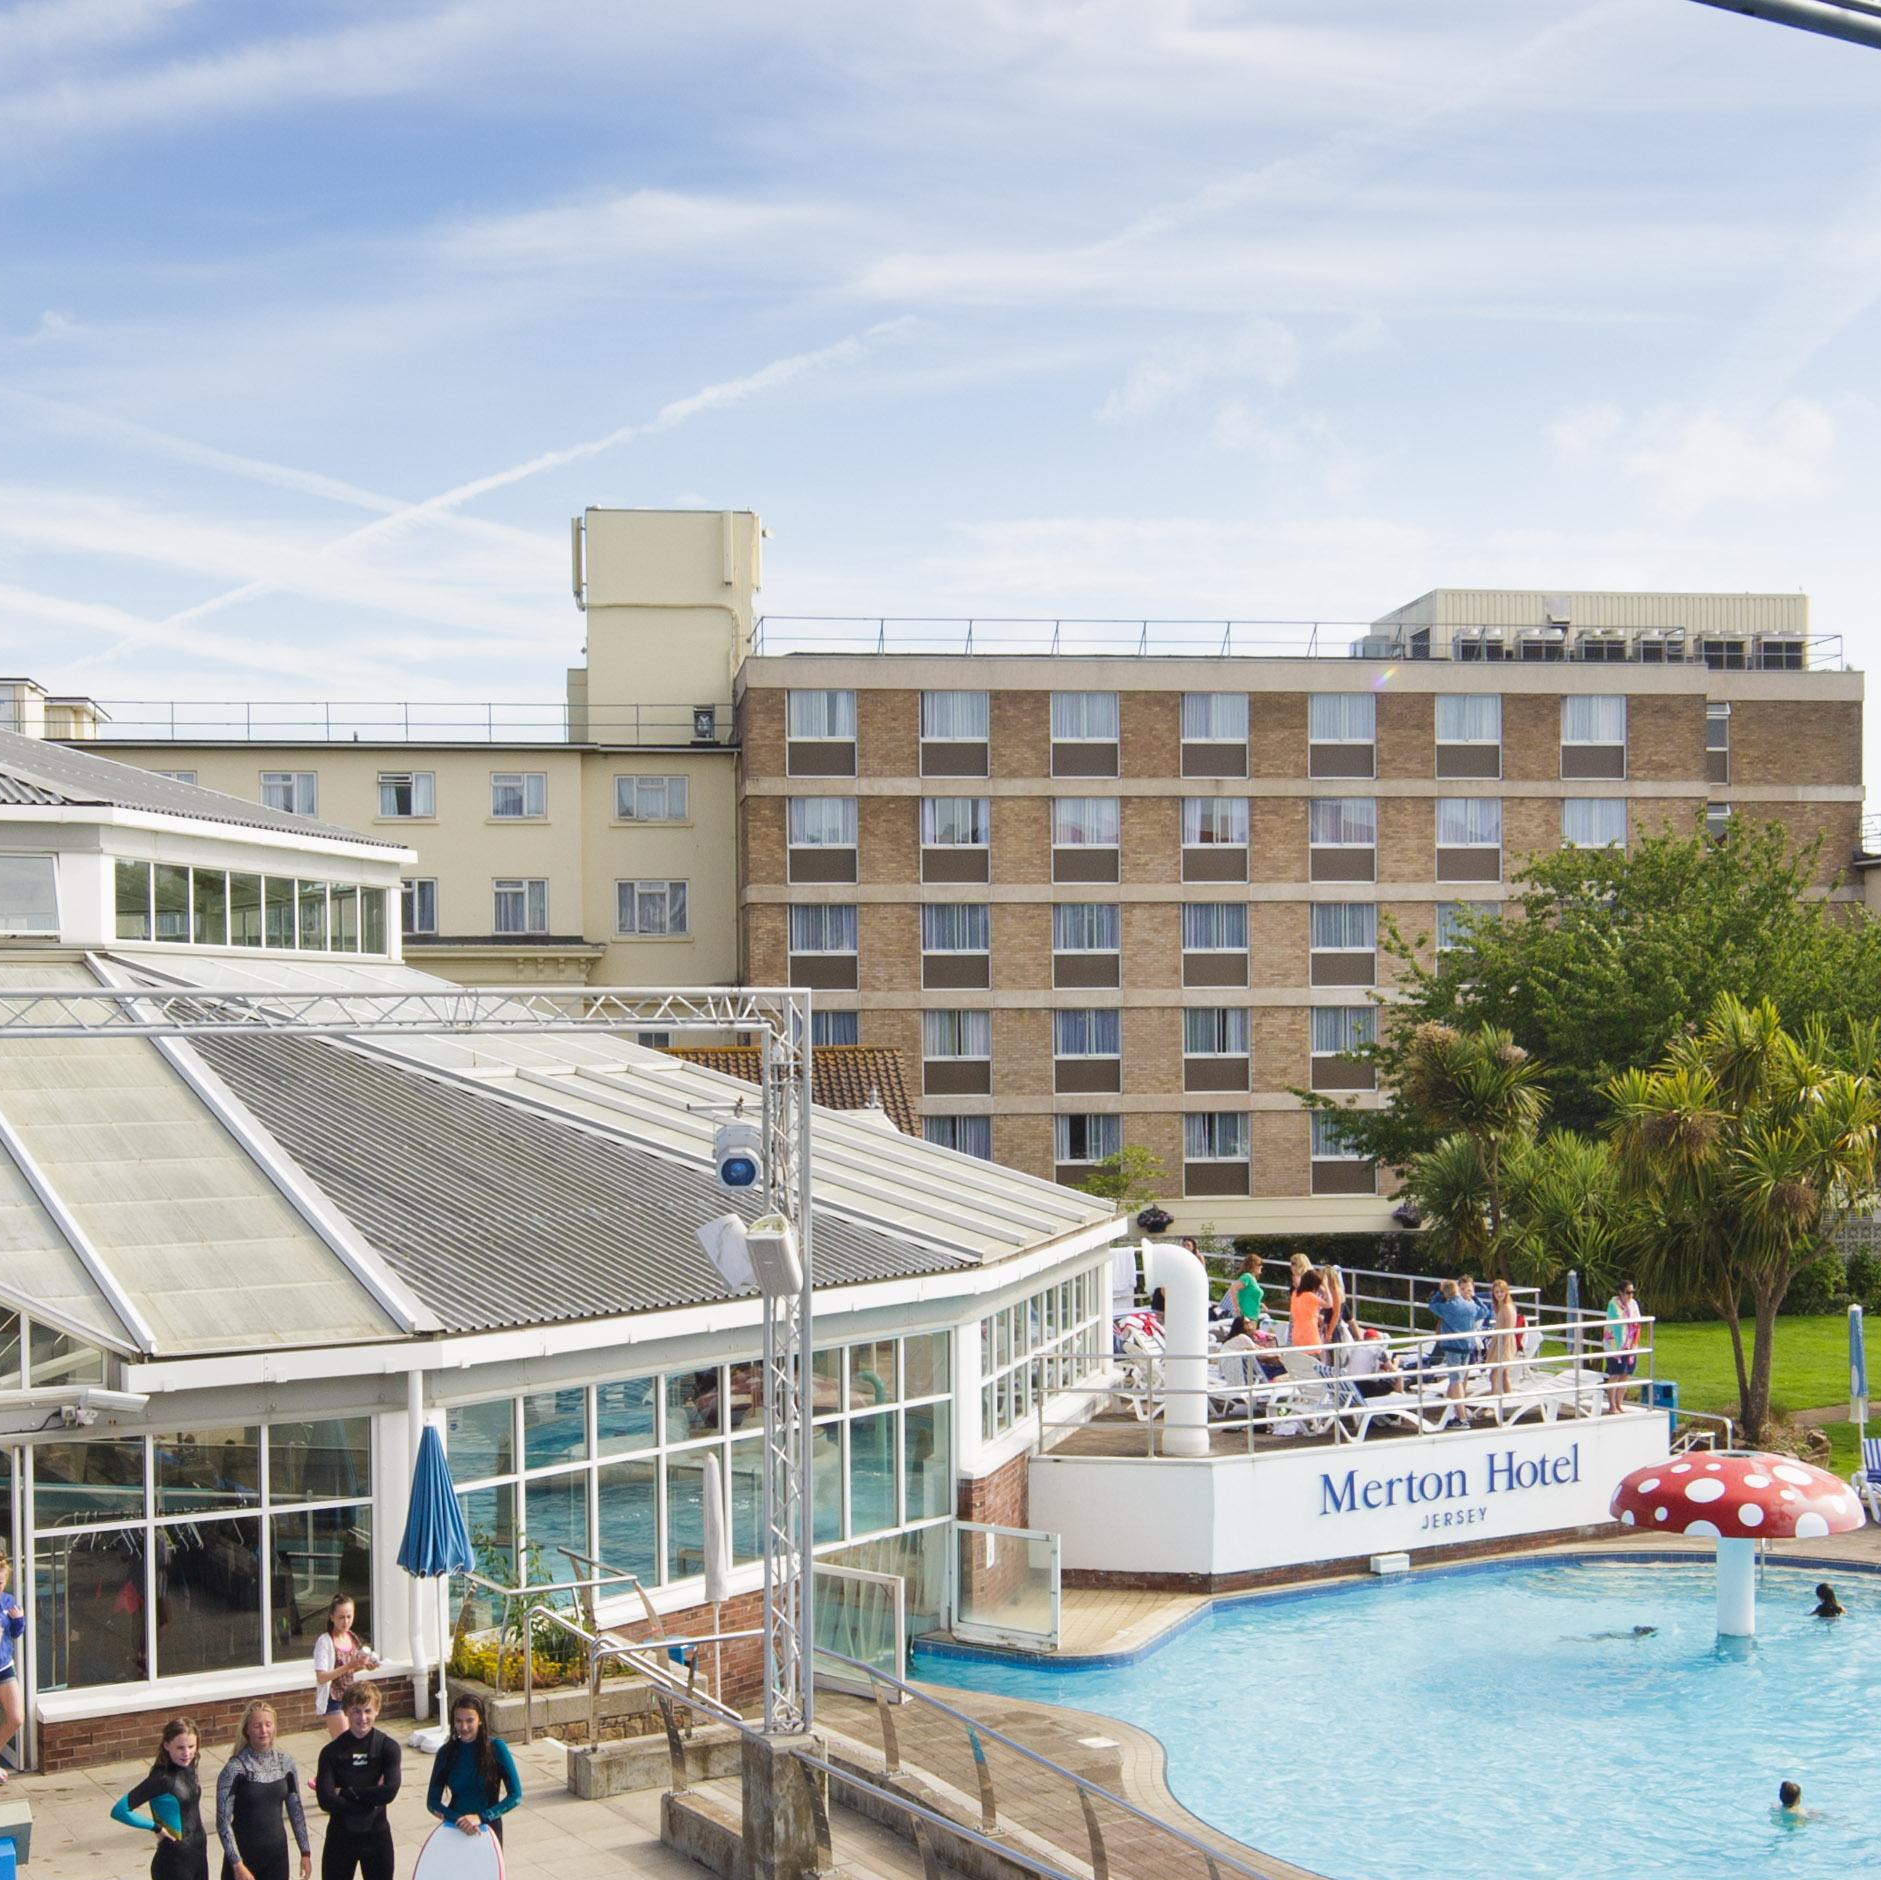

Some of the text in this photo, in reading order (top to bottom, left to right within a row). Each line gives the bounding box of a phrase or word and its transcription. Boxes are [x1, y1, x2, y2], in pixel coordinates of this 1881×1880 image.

[1319, 1442, 1582, 1516] Merton Hotel
[1421, 1507, 1488, 1530] JERSEY
